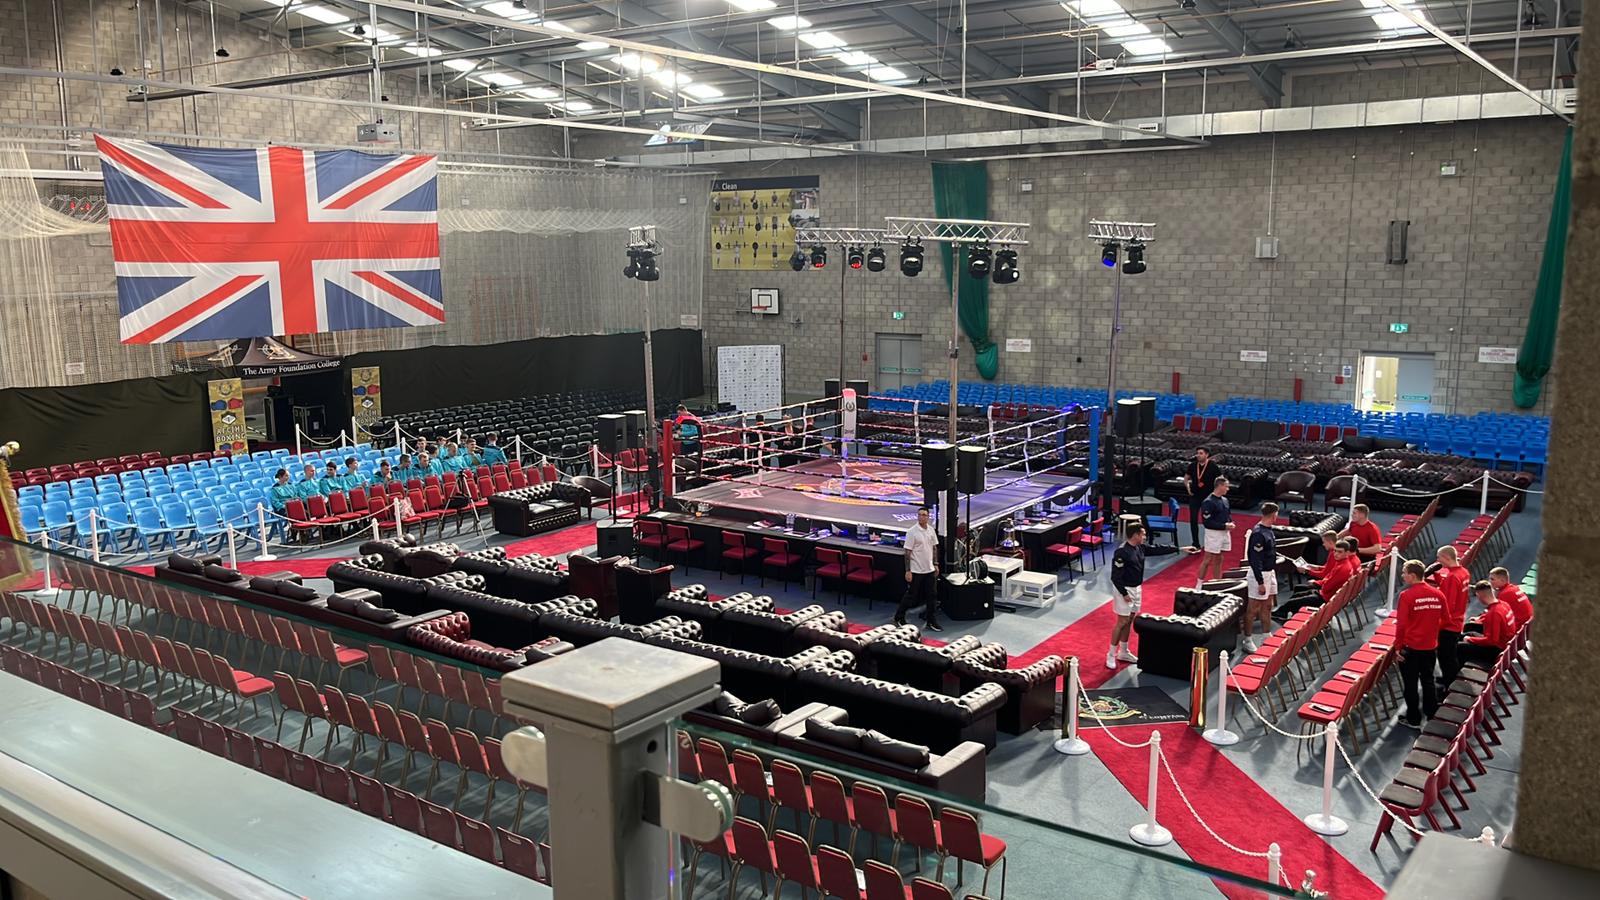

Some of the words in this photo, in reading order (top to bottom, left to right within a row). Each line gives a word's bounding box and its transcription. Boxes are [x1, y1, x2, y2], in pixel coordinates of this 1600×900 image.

[721, 181, 738, 190] Clean
[242, 367, 257, 376] The
[258, 367, 277, 375] Army
[279, 363, 316, 373] Foundation
[316, 360, 341, 369] College
[216, 432, 246, 442] BOXING
